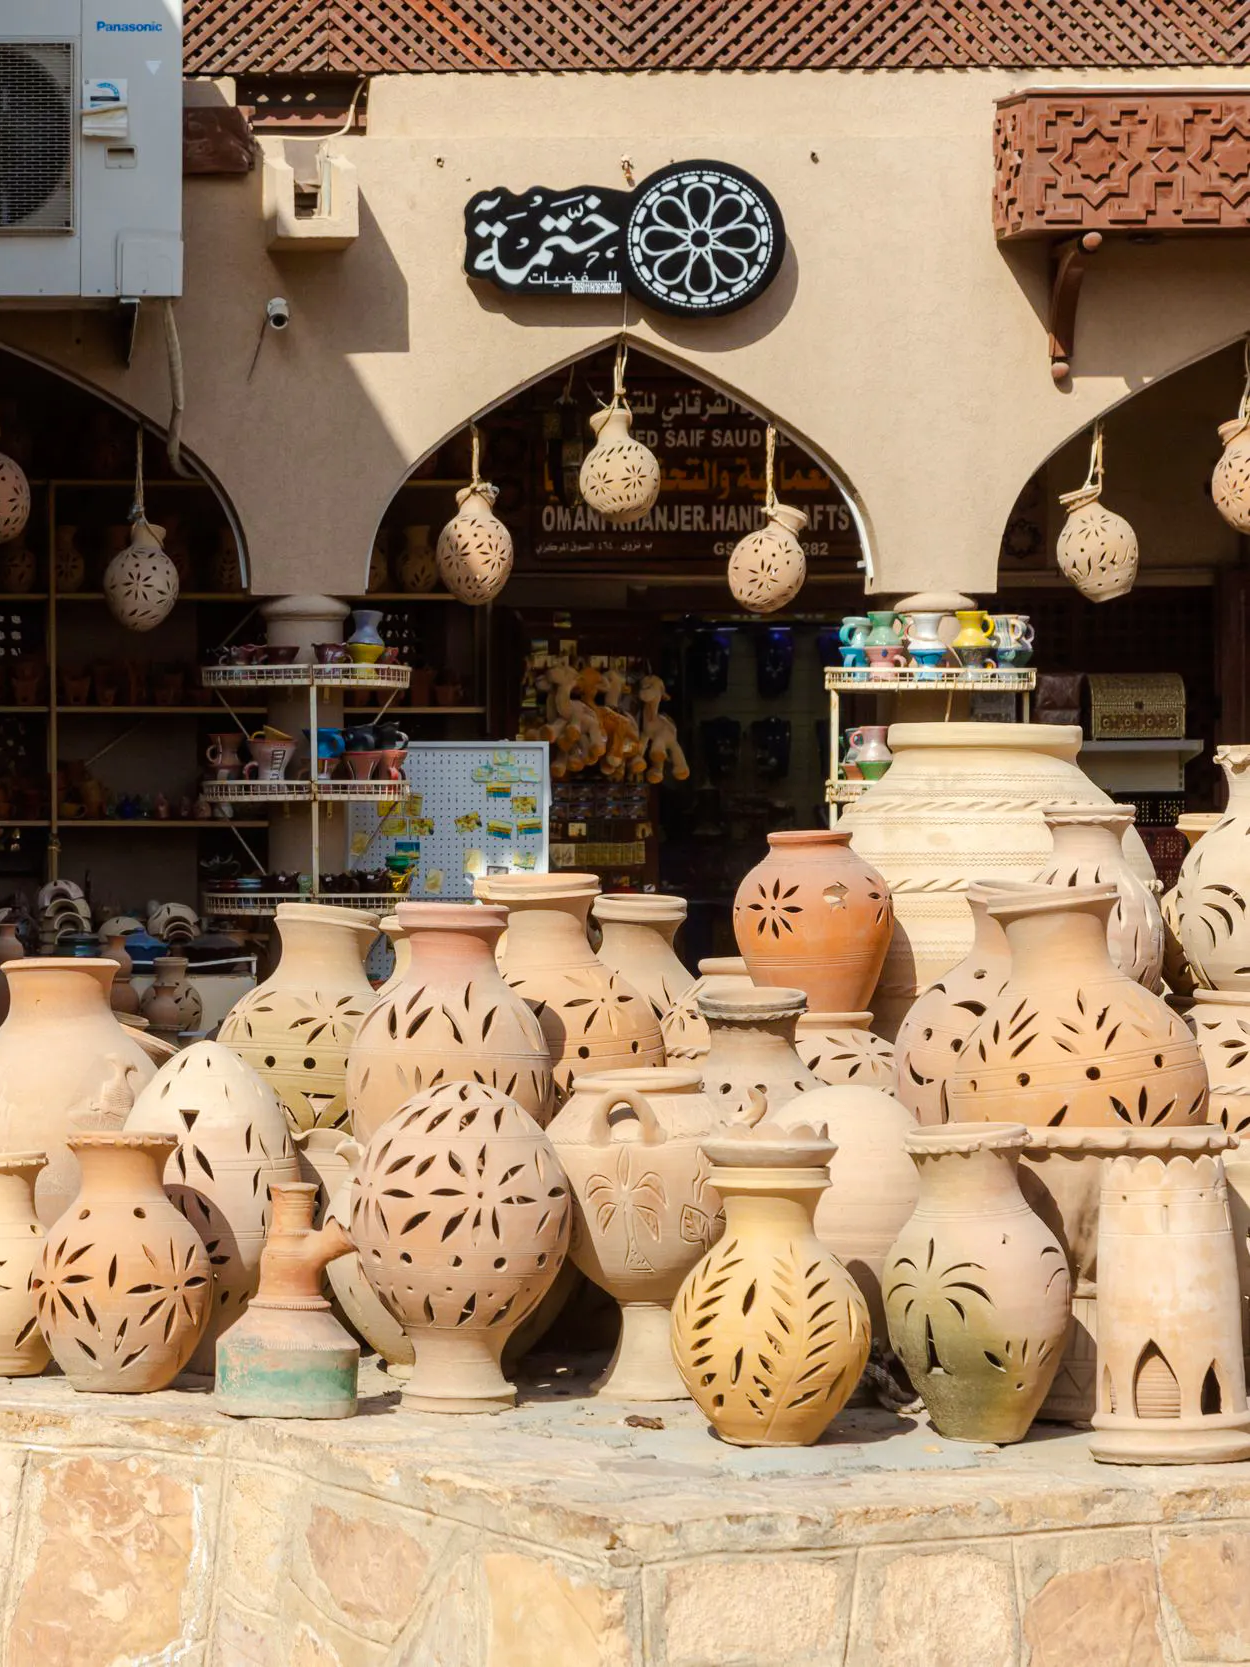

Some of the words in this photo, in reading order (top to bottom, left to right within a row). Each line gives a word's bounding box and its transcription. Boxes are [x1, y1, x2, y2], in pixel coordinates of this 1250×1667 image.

[96, 20, 163, 33] Panasonic
[664, 429, 706, 449] SAIF
[711, 429, 763, 449] SAUD
[541, 504, 607, 532] OMANI
